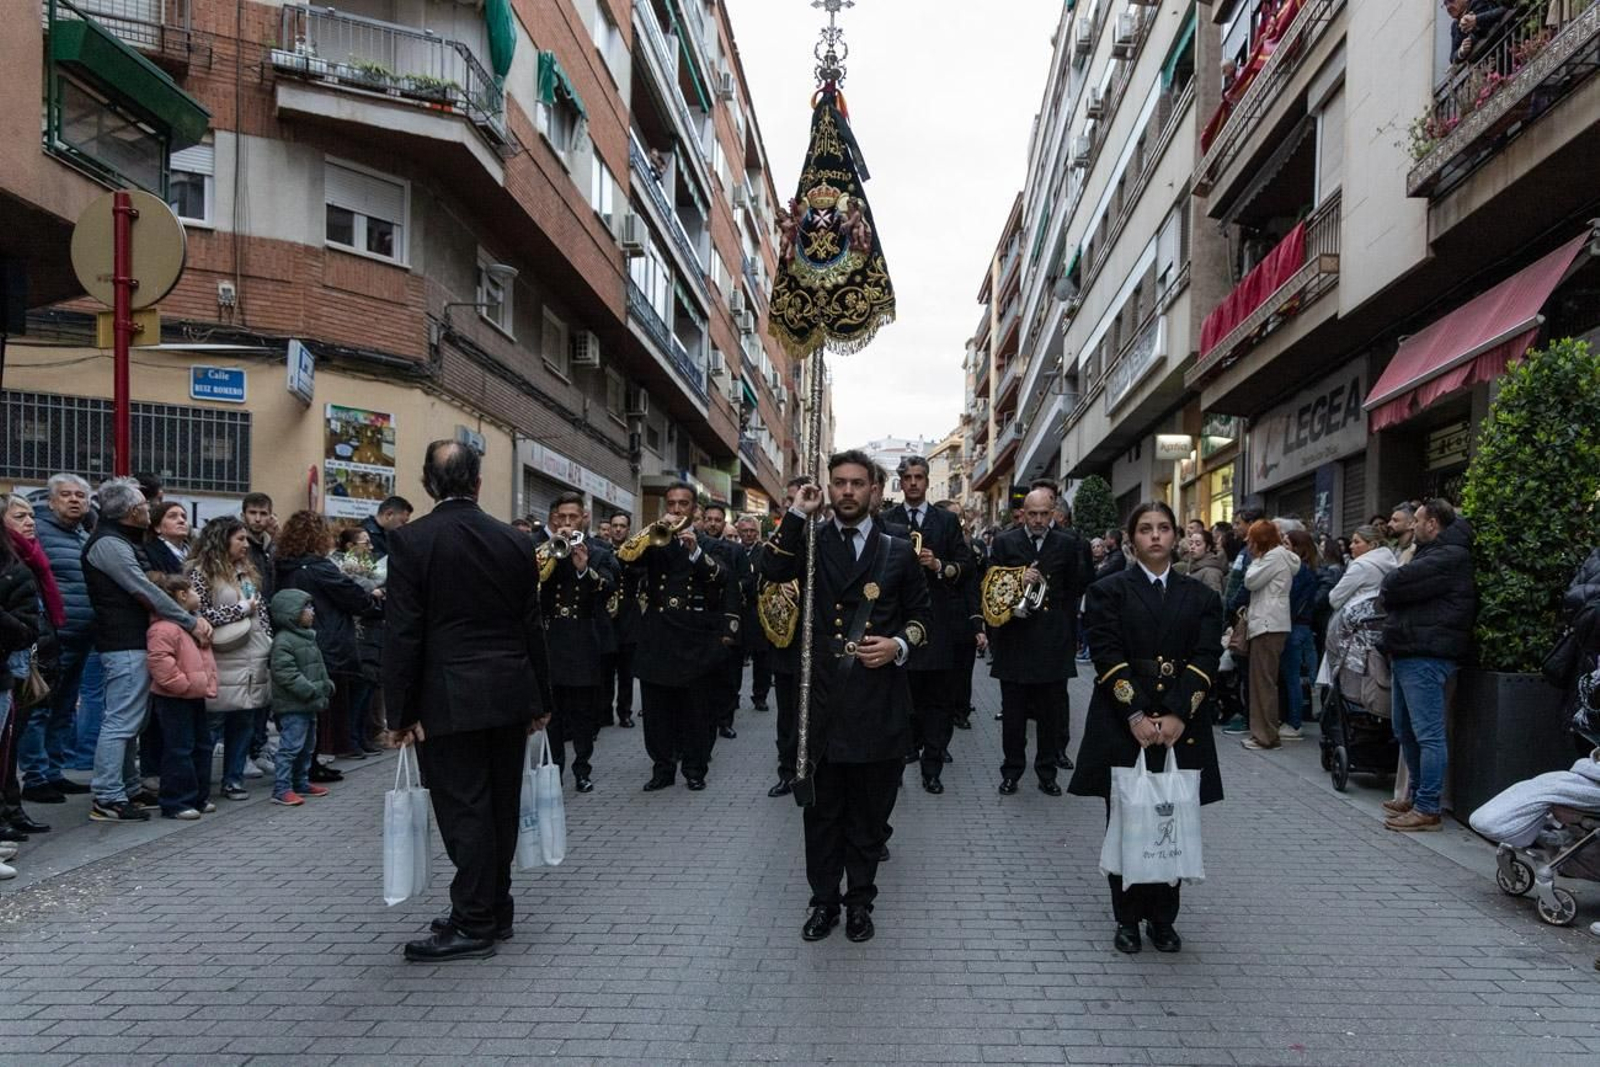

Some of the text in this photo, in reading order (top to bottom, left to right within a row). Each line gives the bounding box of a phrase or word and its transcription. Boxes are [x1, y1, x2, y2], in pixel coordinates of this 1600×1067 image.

[801, 165, 852, 189] Rosario
[208, 369, 229, 380] Calle
[195, 384, 242, 395] RUIZ ROMERO
[1283, 376, 1360, 456] LEGEA
